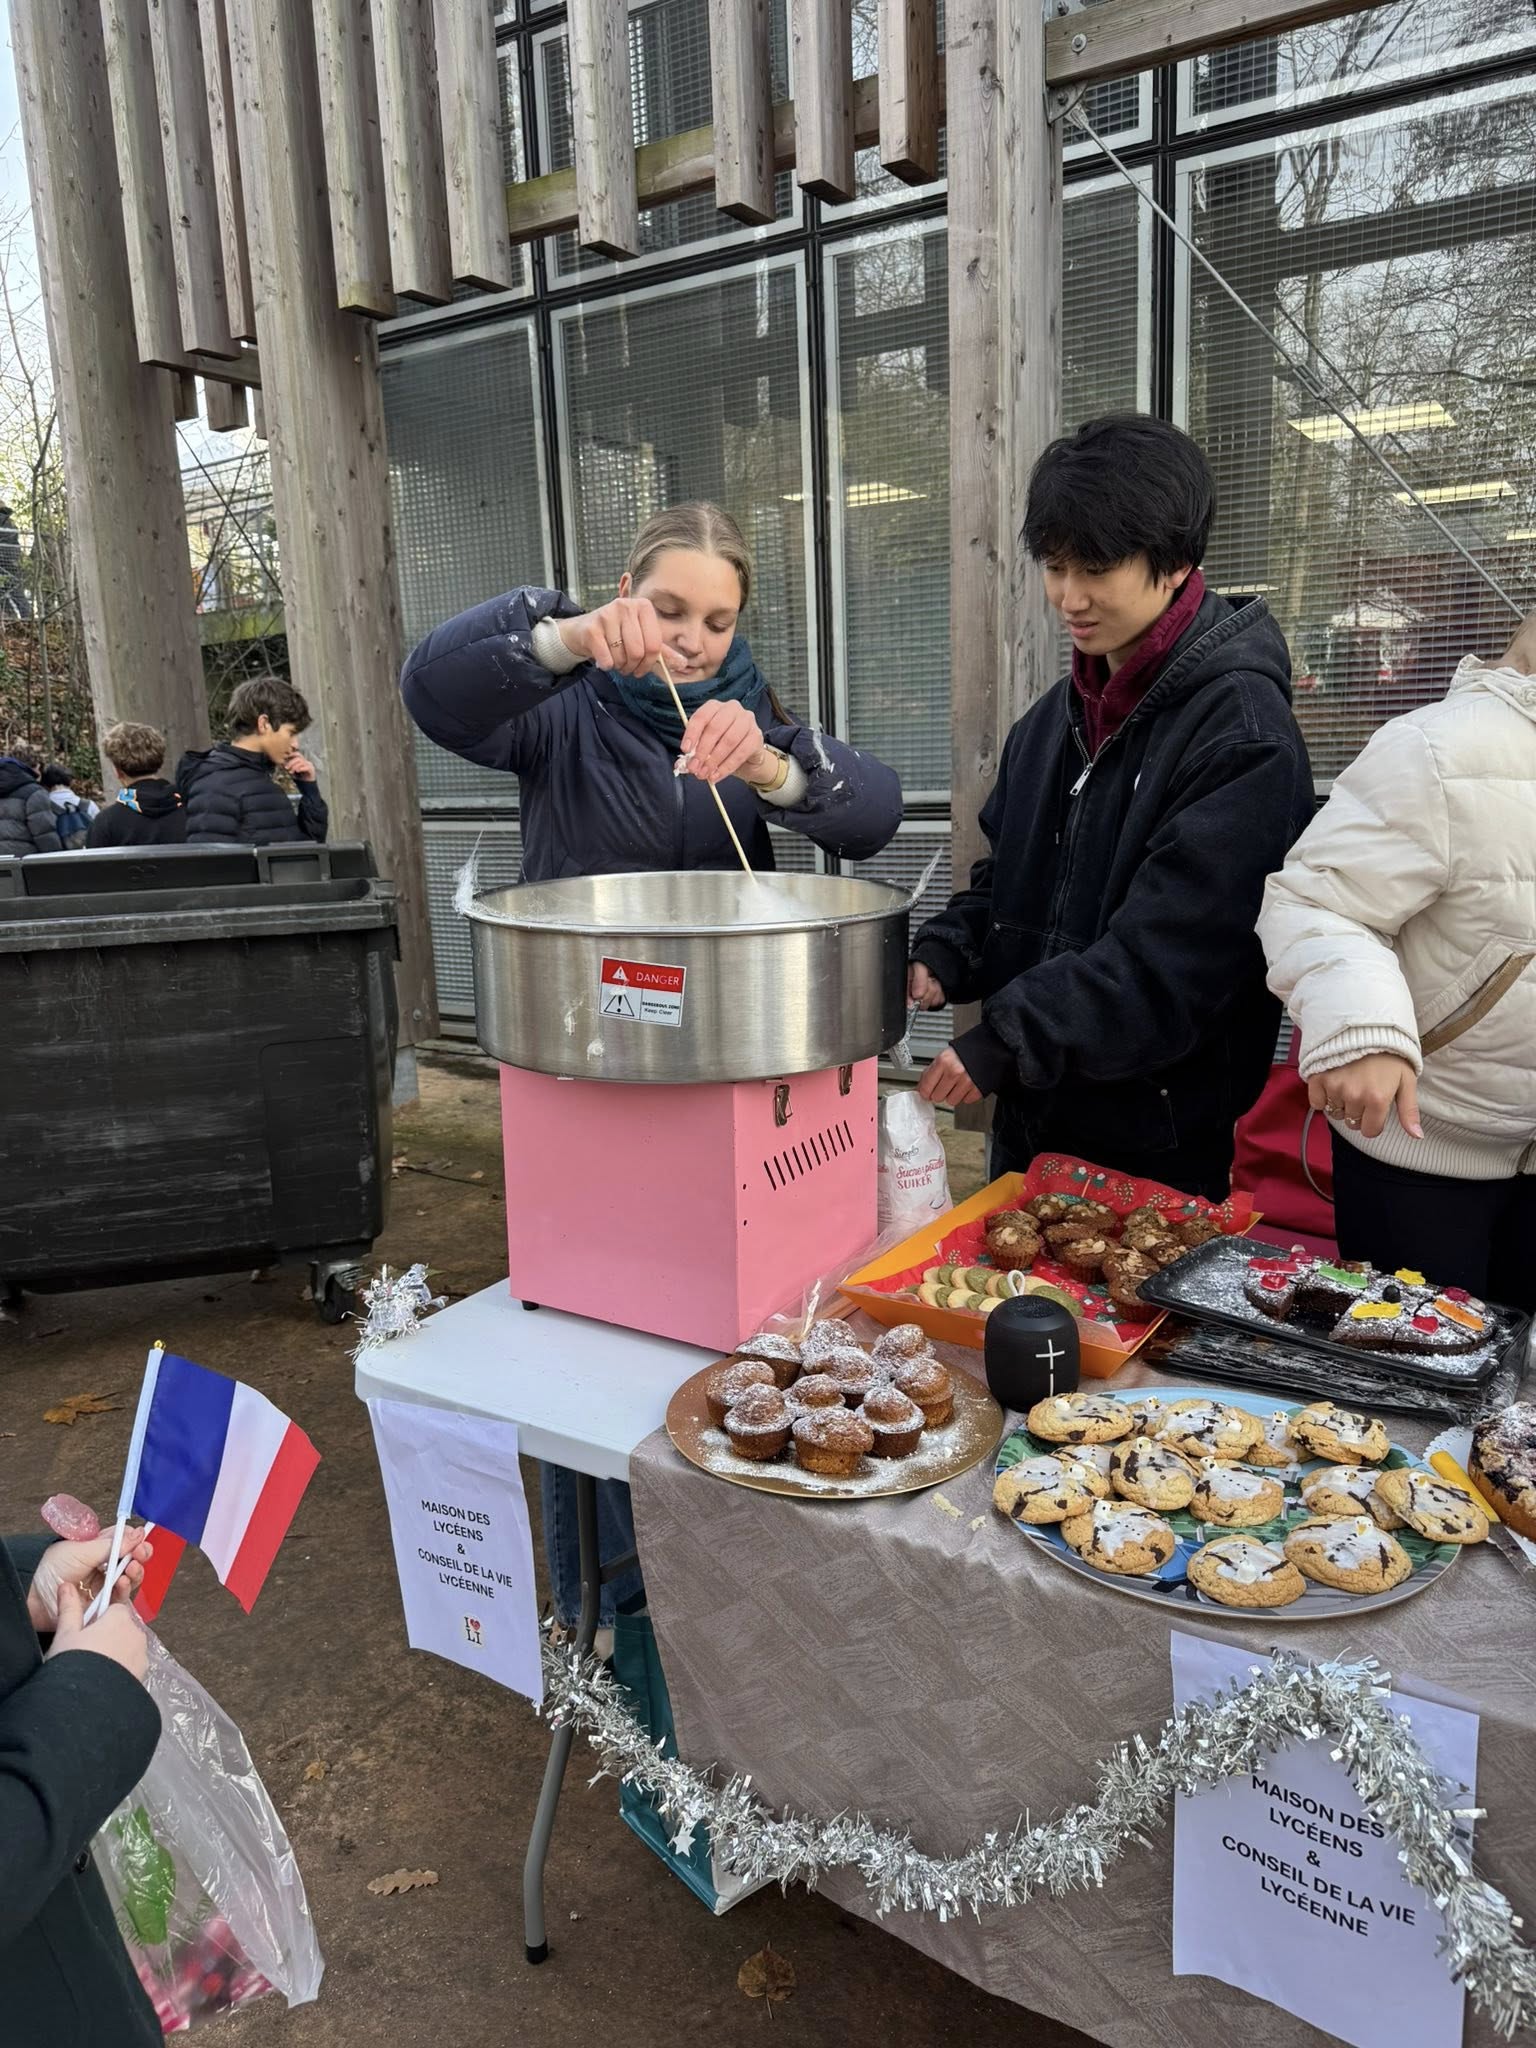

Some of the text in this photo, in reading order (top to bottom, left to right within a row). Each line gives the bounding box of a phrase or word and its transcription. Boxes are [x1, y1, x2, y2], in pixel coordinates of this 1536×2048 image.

[636, 971, 680, 986] DANGER
[896, 1165, 921, 1179] Sucre
[897, 1174, 932, 1190] SUIKER
[421, 1499, 491, 1526] MAISON DES
[433, 1520, 484, 1542] LYCÉENS
[456, 1543, 466, 1556] &
[417, 1547, 513, 1588] CONSEIL DE LA VIE
[439, 1573, 495, 1599] LYCÉENNE
[1252, 1775, 1386, 1839] MAISON DES
[1269, 1807, 1364, 1858] LYCÉENS
[1306, 1849, 1321, 1868] &
[1222, 1835, 1416, 1926] CONSEIL DE LA VIE
[1260, 1876, 1369, 1936] LYCÉENNE
